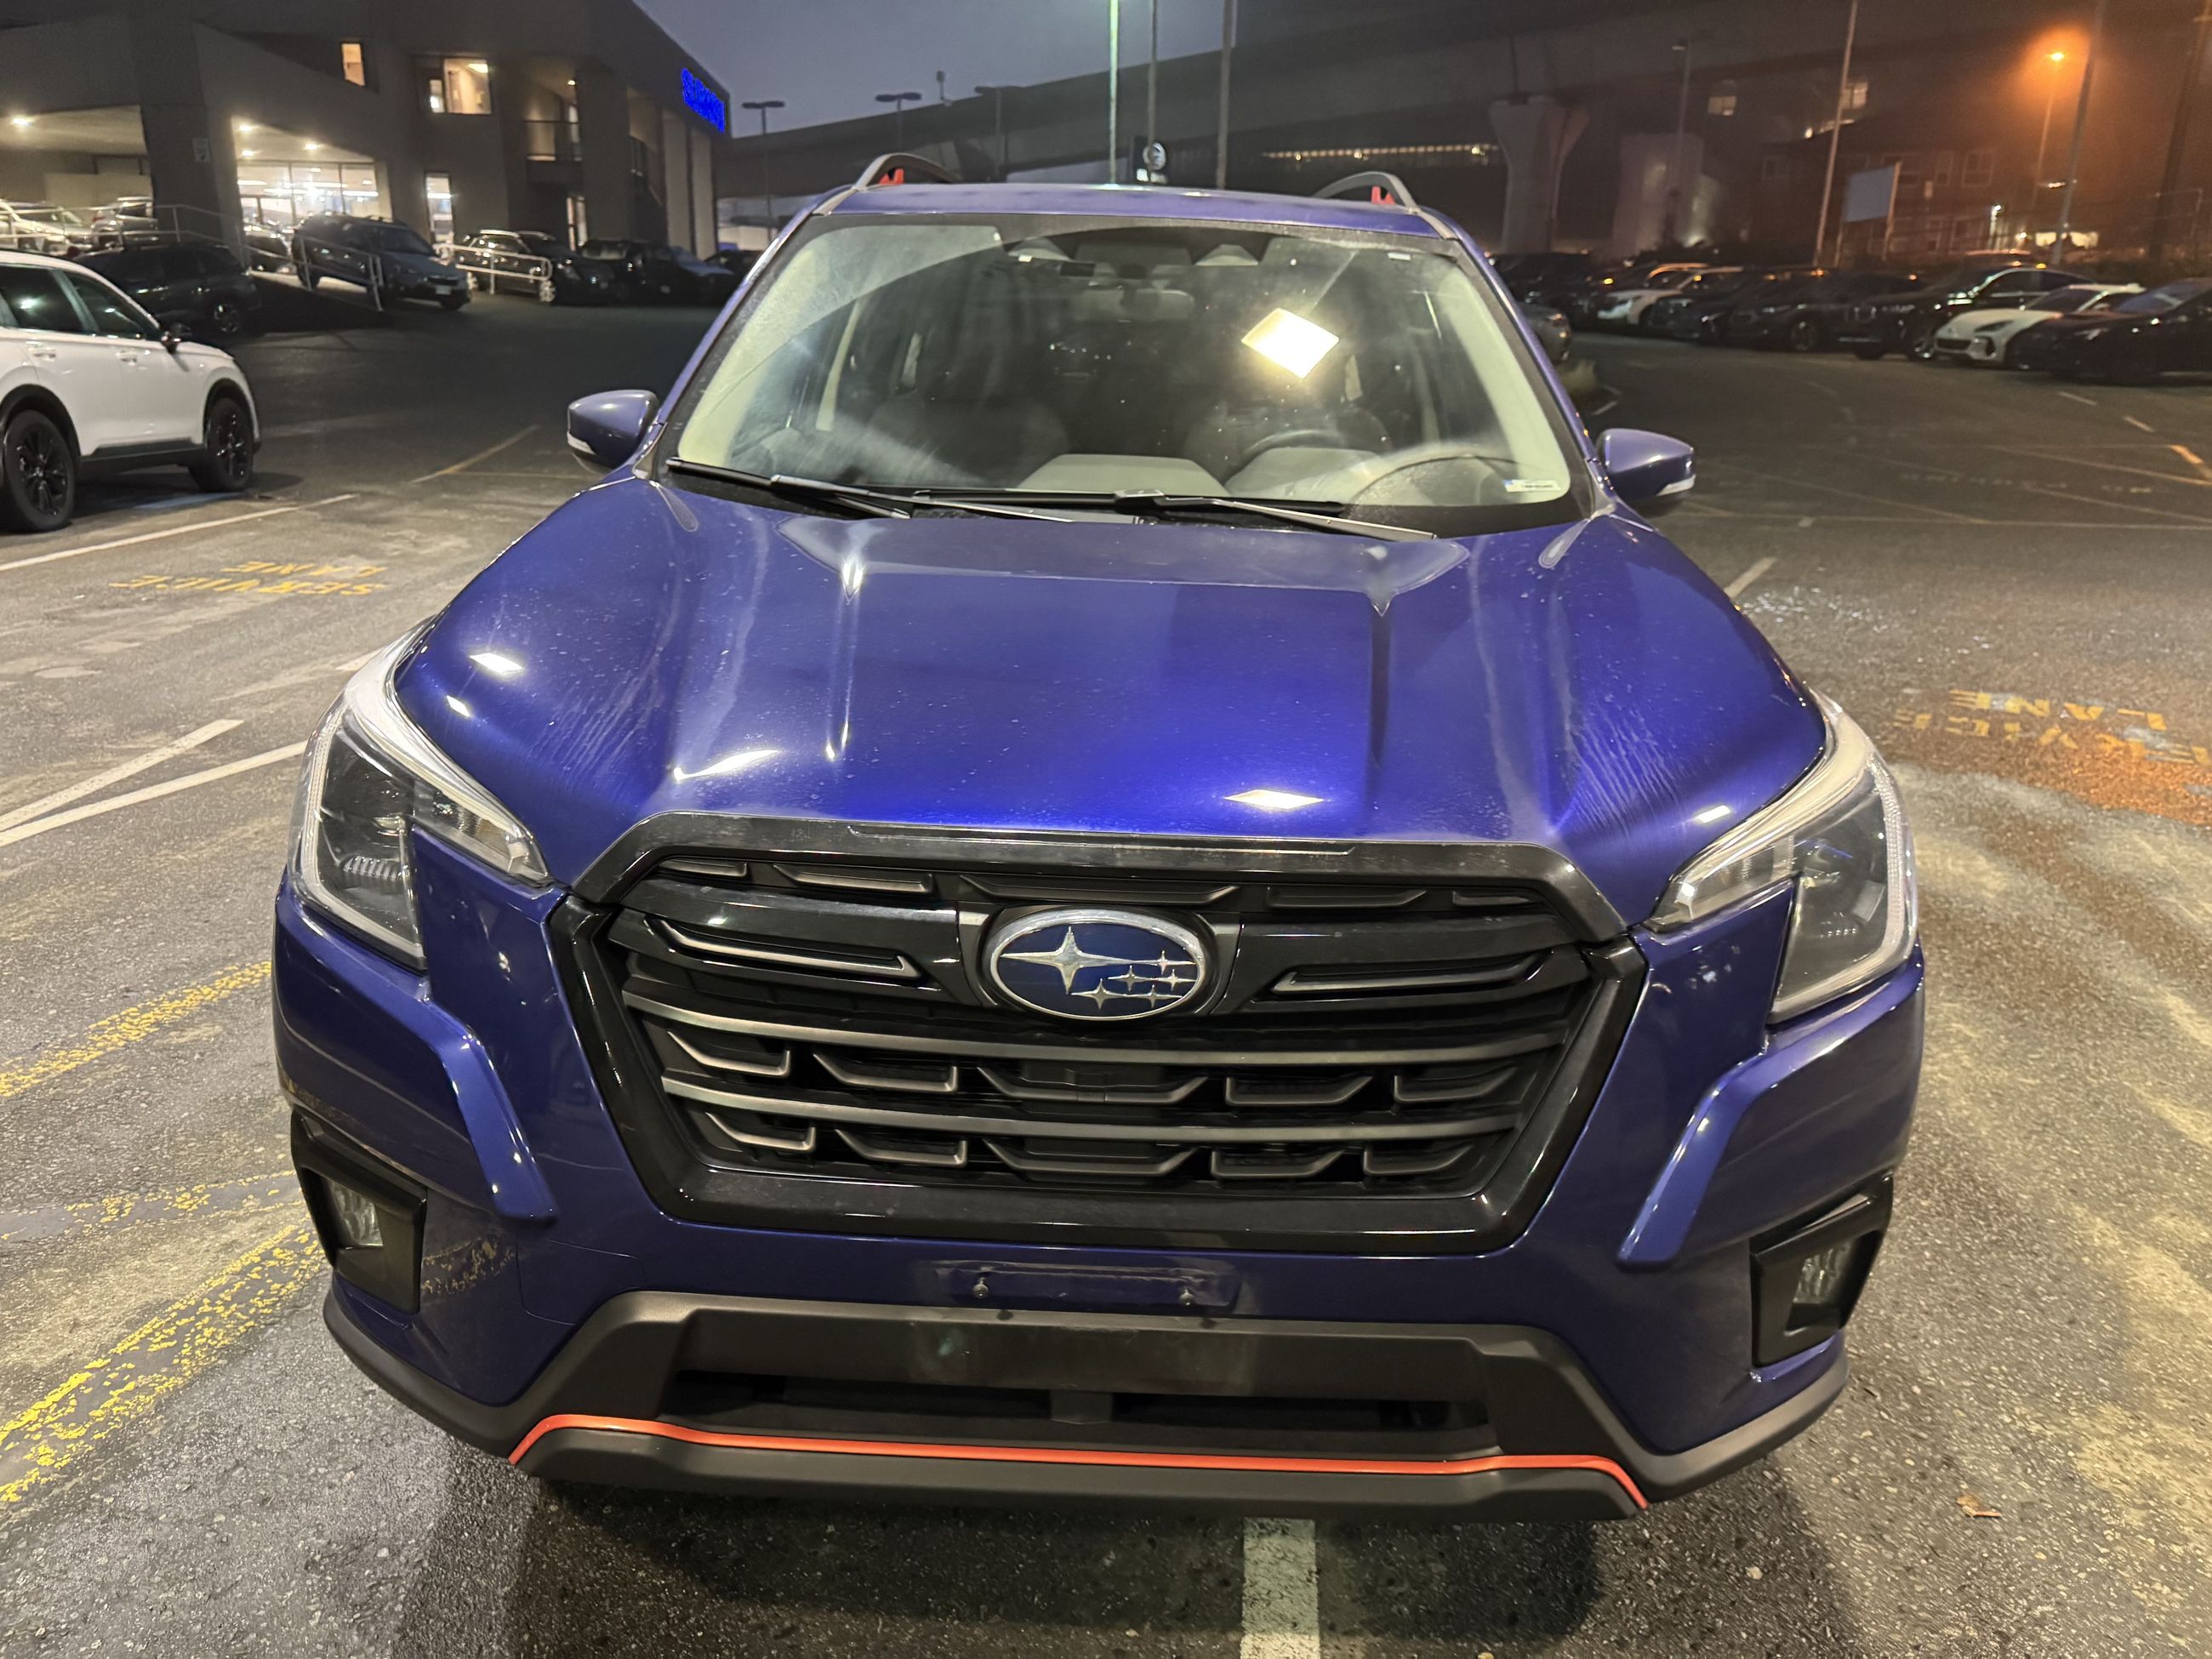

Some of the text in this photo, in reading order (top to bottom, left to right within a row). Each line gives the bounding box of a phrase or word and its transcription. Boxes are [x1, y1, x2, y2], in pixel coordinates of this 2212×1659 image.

[109, 575, 388, 595] SERVICE
[1949, 689, 2168, 731] LANE
[1892, 709, 2211, 766] ERVICE
